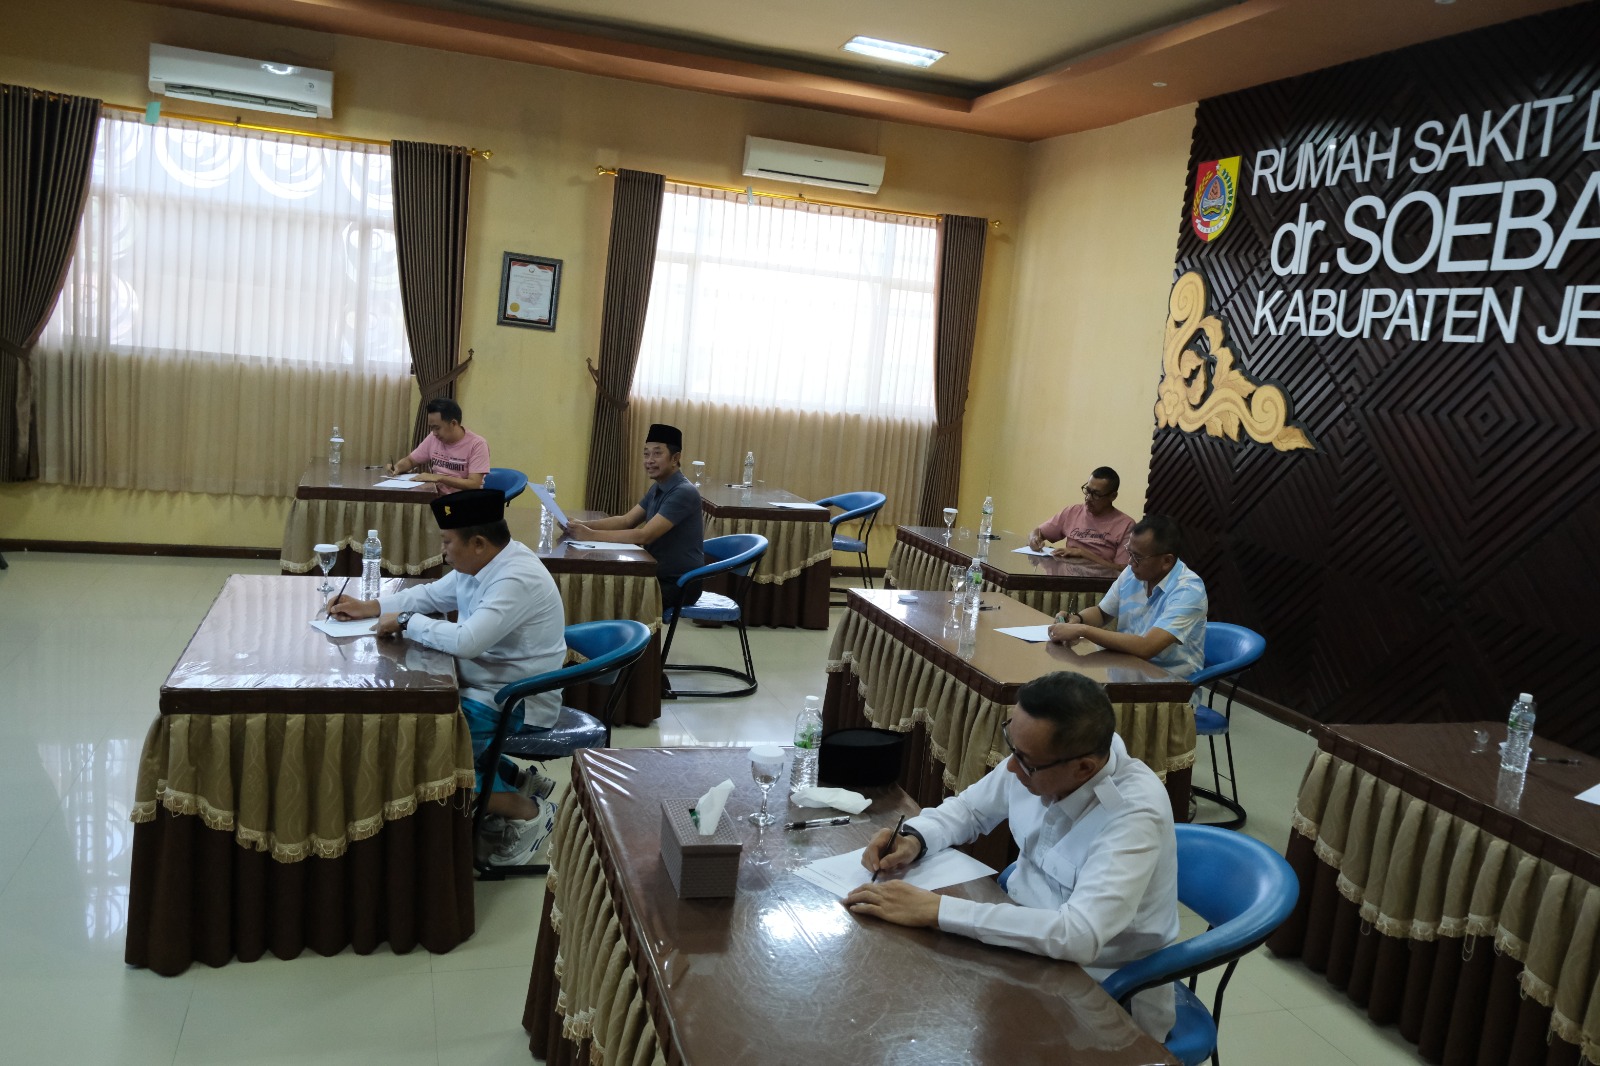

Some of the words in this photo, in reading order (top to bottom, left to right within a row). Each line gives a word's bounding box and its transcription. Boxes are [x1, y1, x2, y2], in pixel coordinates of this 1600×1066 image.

[1251, 126, 1401, 196] RUMAH
[1409, 94, 1575, 174] SAKIT
[1252, 285, 1523, 345] KABUPATEN
